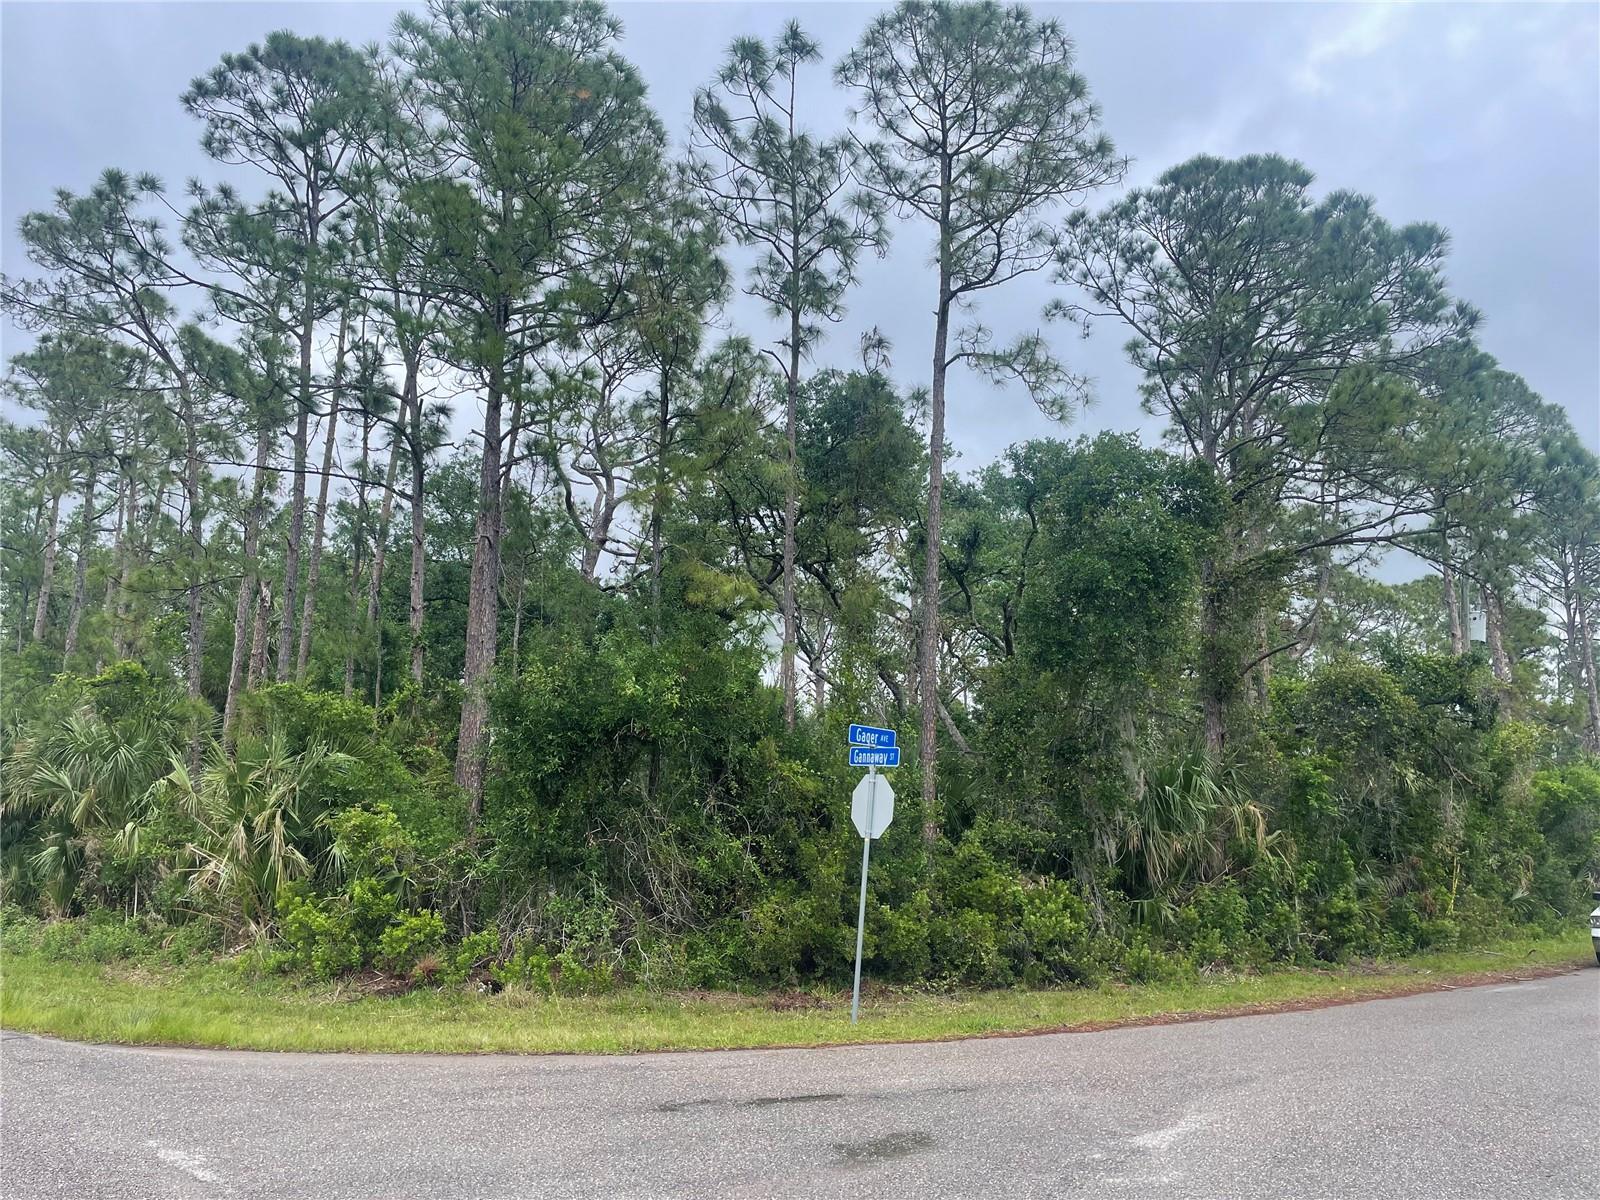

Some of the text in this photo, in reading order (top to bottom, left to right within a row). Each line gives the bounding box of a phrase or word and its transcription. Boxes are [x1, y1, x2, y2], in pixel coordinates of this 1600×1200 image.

[856, 728, 889, 745] Gager AVE
[853, 749, 895, 766] Gannaway ST
